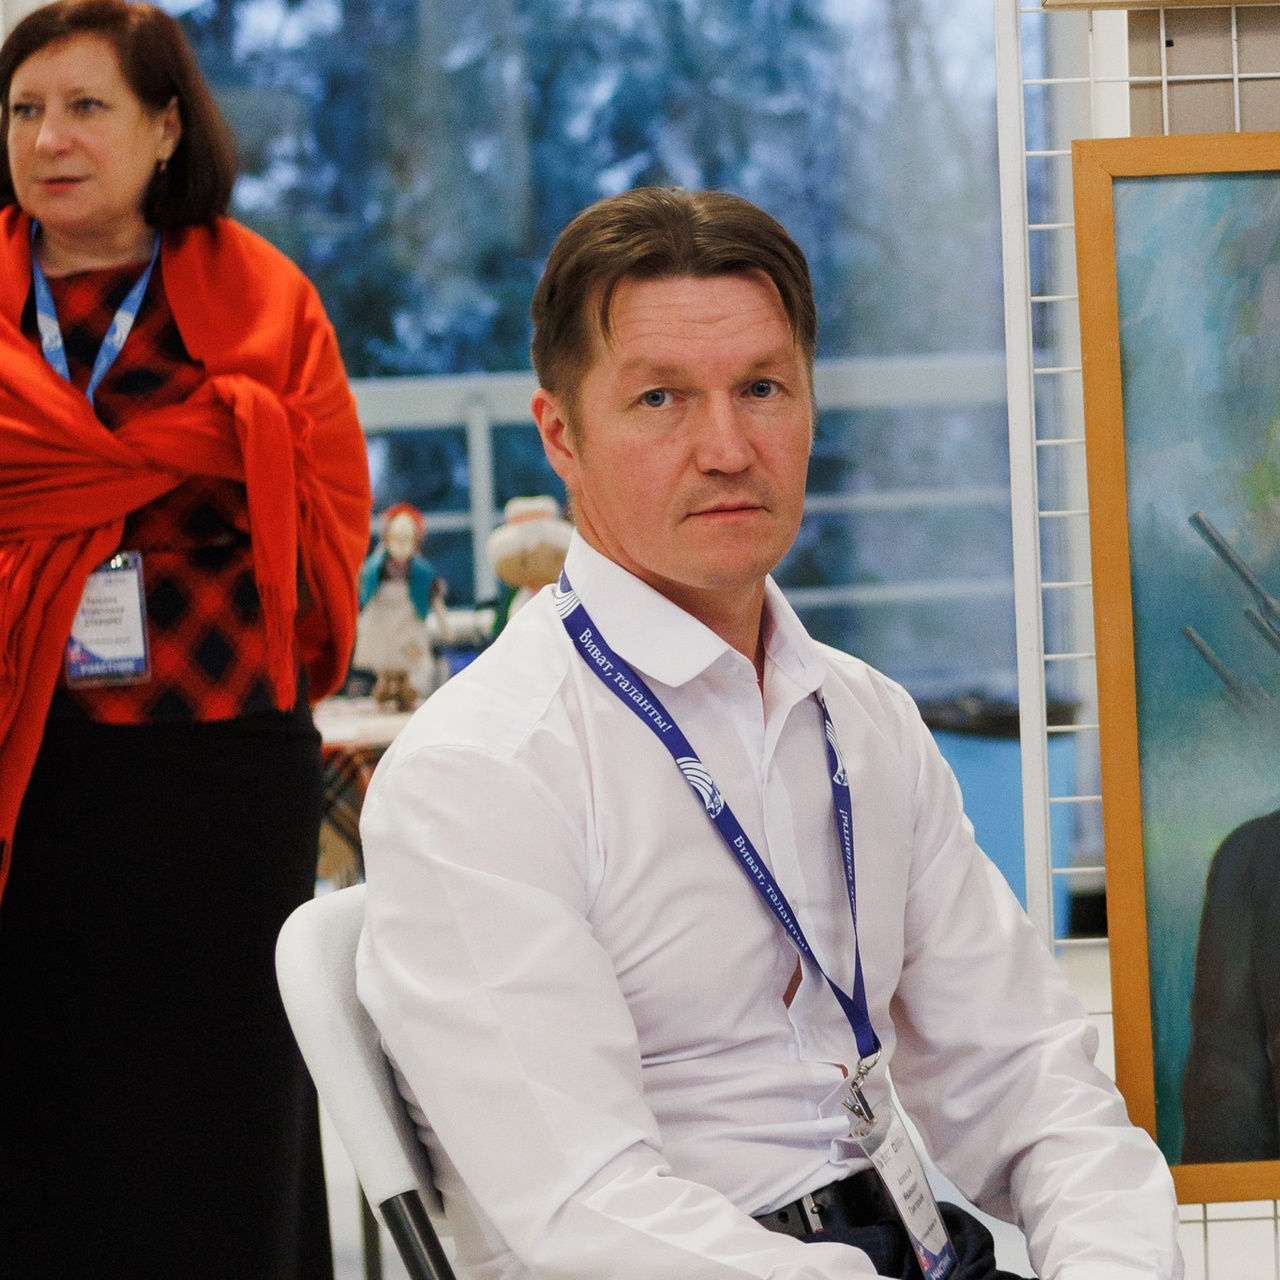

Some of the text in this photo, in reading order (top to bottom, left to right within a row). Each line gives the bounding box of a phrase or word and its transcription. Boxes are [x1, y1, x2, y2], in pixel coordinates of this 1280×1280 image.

[578, 627, 673, 734] Виват, таланты!
[733, 834, 766, 886] Виват,
